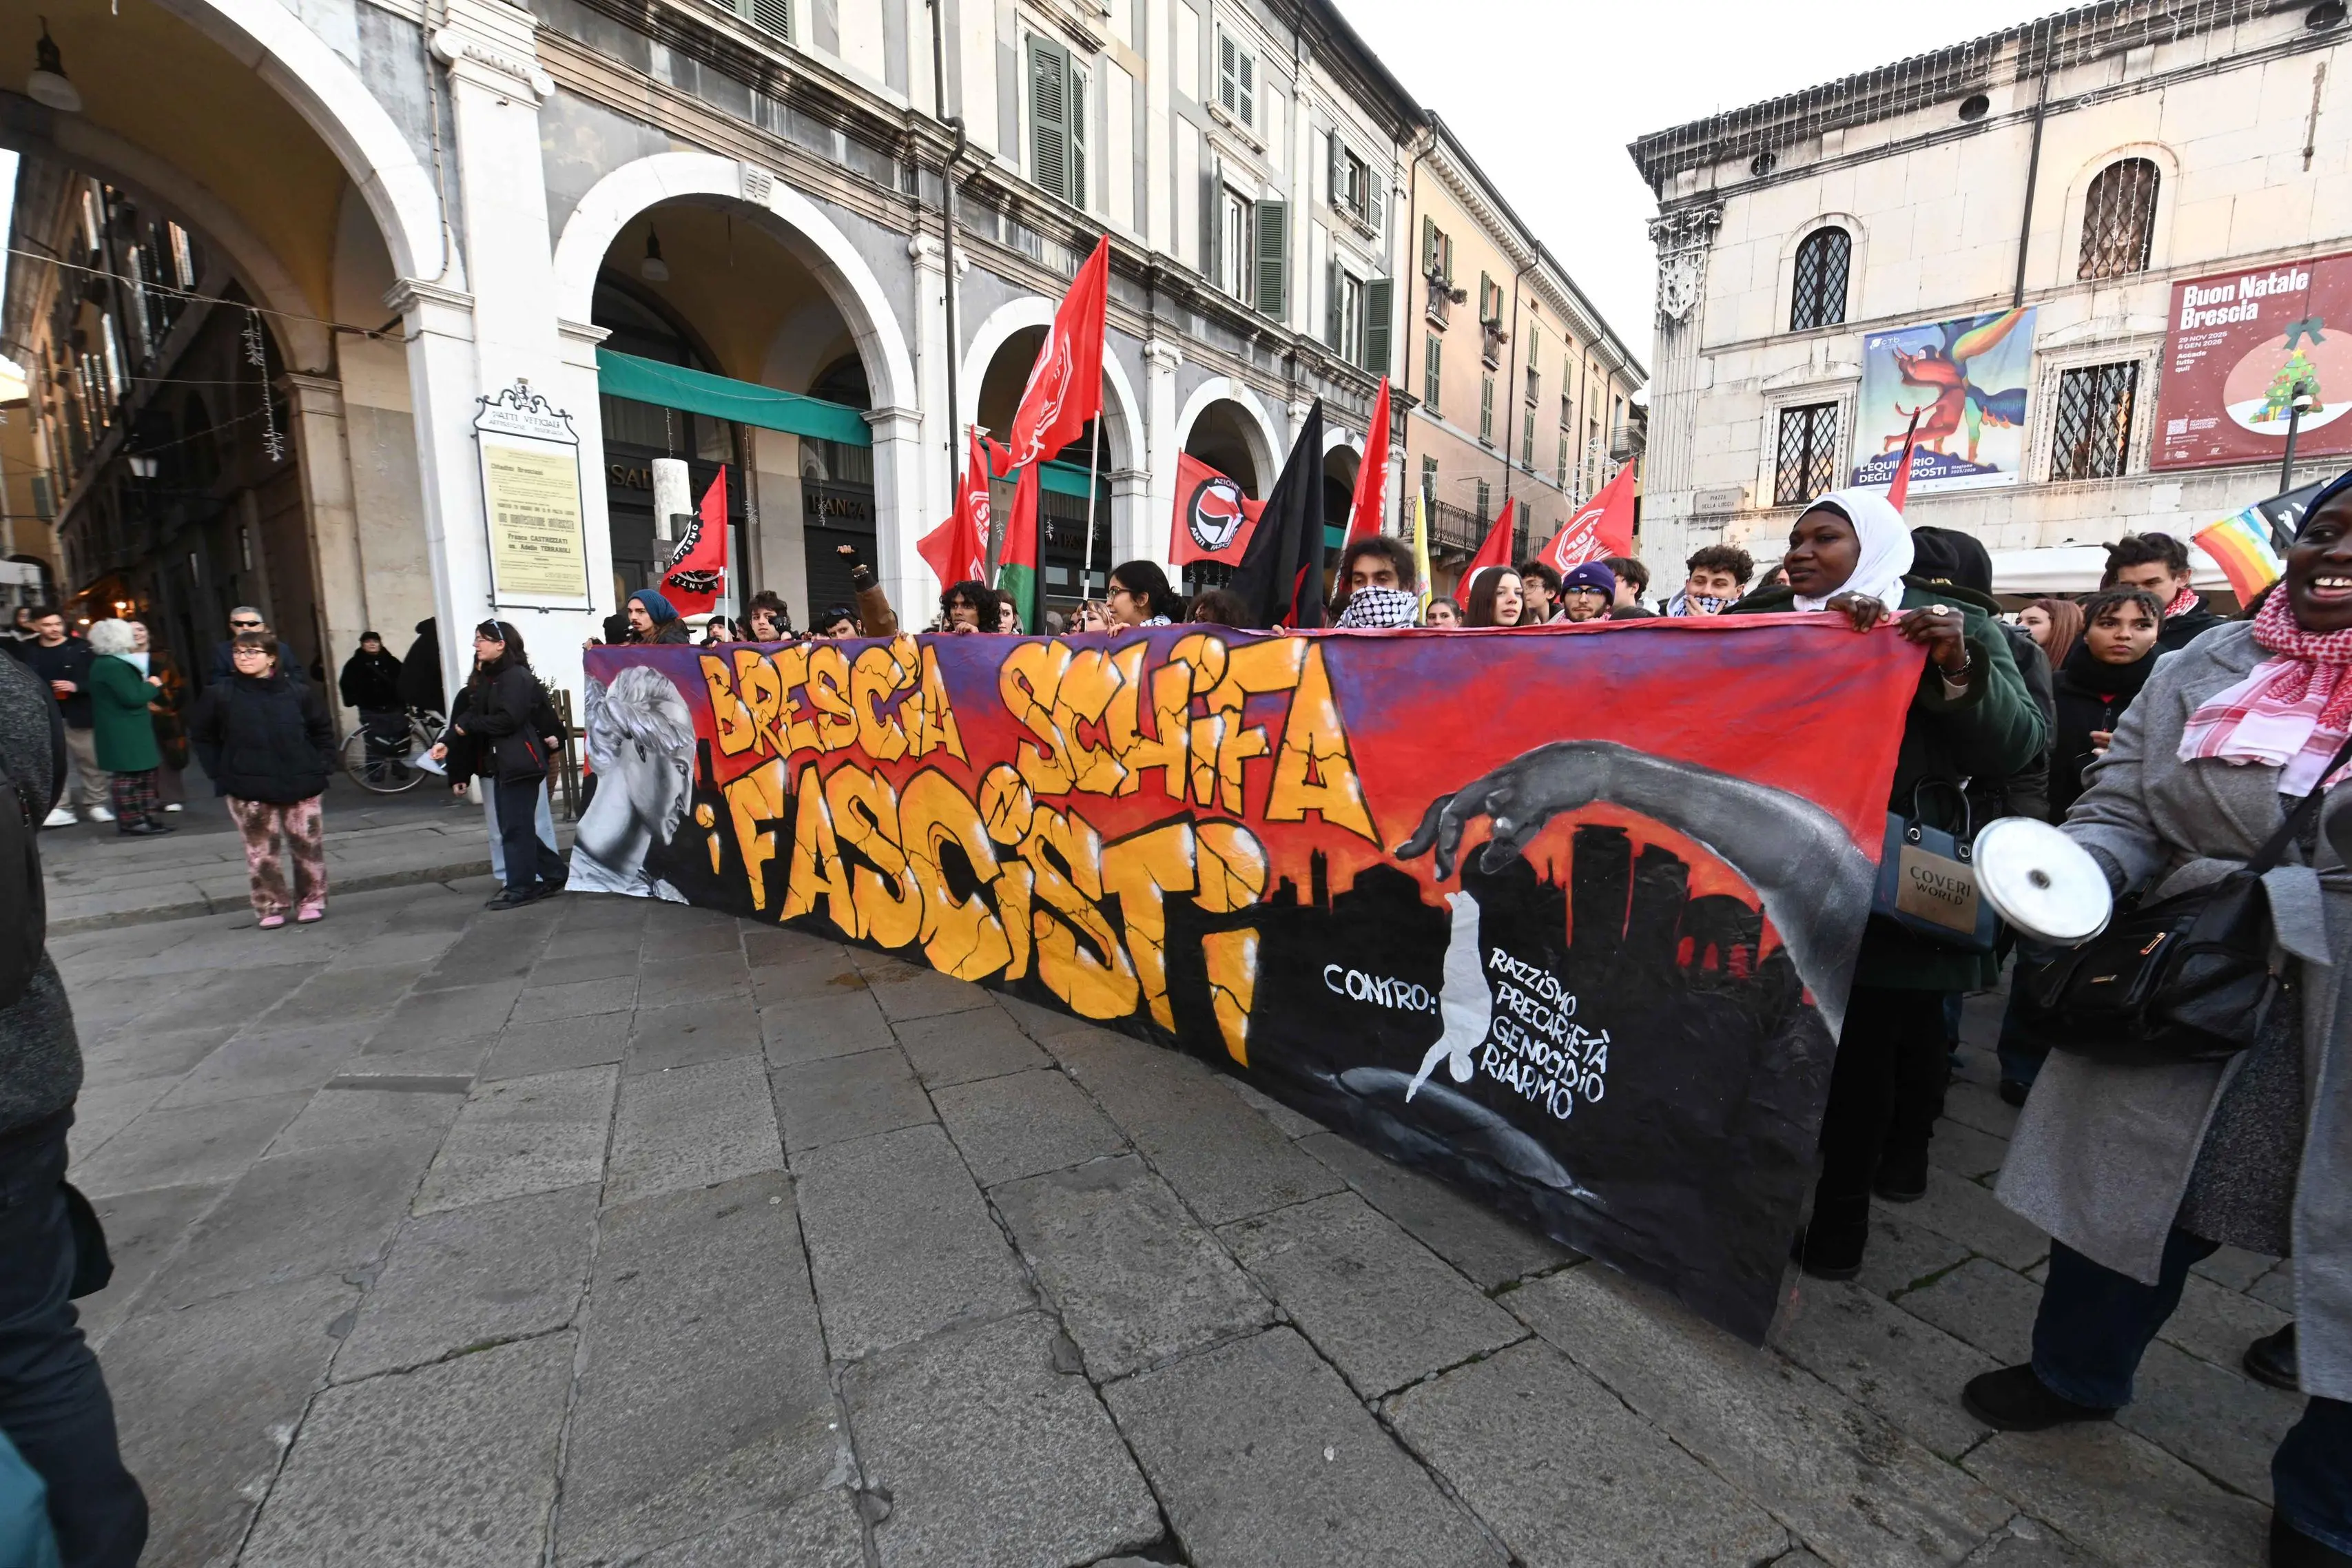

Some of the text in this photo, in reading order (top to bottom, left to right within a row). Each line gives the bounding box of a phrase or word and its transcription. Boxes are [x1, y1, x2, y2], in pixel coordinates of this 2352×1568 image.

[2183, 268, 2309, 309] Buon Natale
[2180, 298, 2258, 330] Brescia
[2203, 338, 2222, 347] 2026
[2177, 350, 2207, 359] Accade
[1214, 478, 1239, 493] AZIONE
[1859, 472, 1892, 483] DEGLI
[1190, 527, 1206, 546] ANTI
[1910, 866, 1970, 896] COVERI
[1915, 881, 1963, 906] WORLD
[1323, 964, 1436, 1014] CONTRO:
